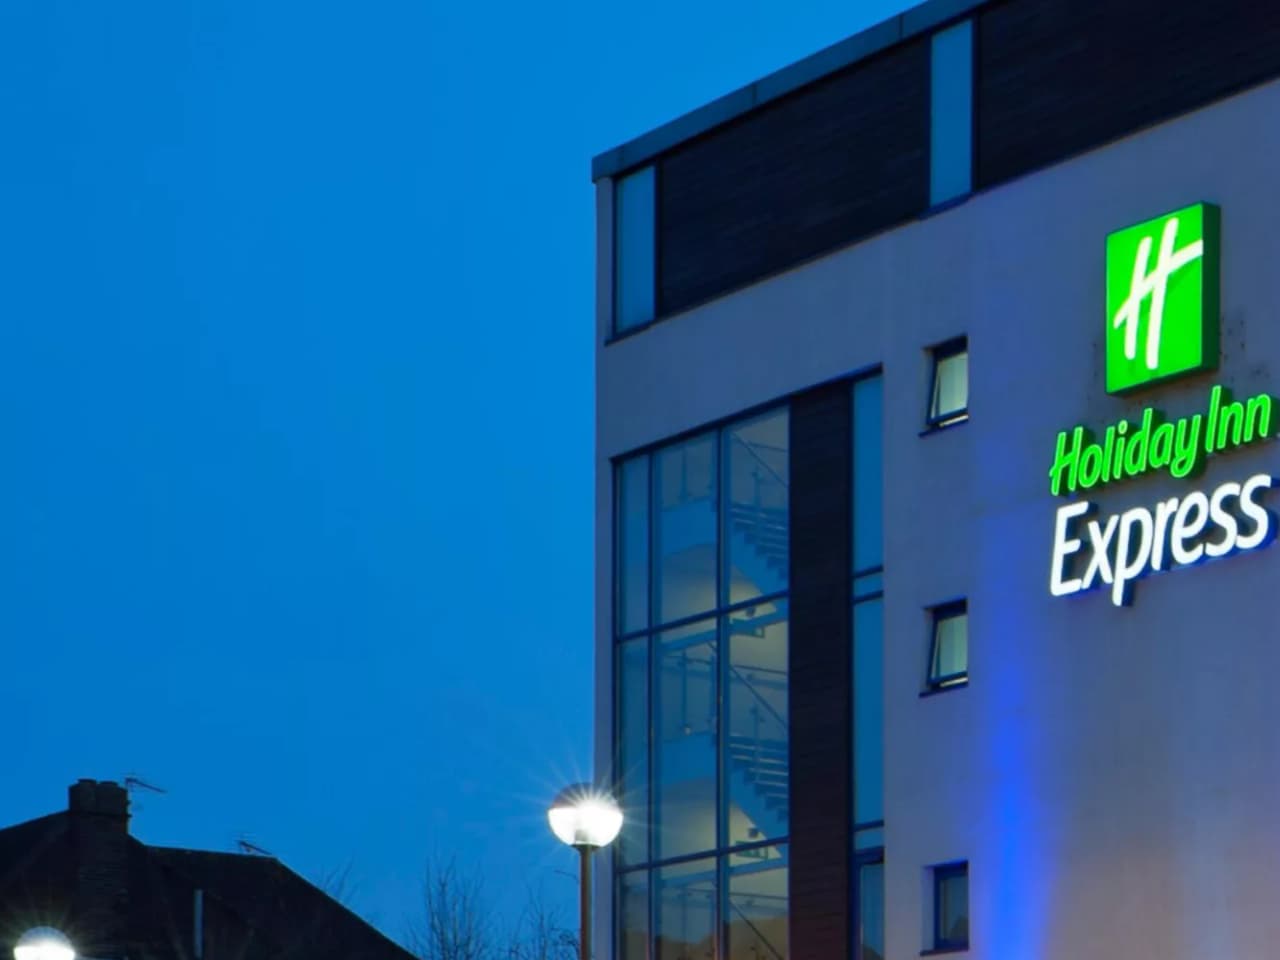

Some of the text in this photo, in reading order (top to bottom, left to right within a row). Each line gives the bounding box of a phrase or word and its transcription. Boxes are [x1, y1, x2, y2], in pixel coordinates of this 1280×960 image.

[1049, 384, 1273, 496] Holiday Inn
[1049, 473, 1273, 606] Express
